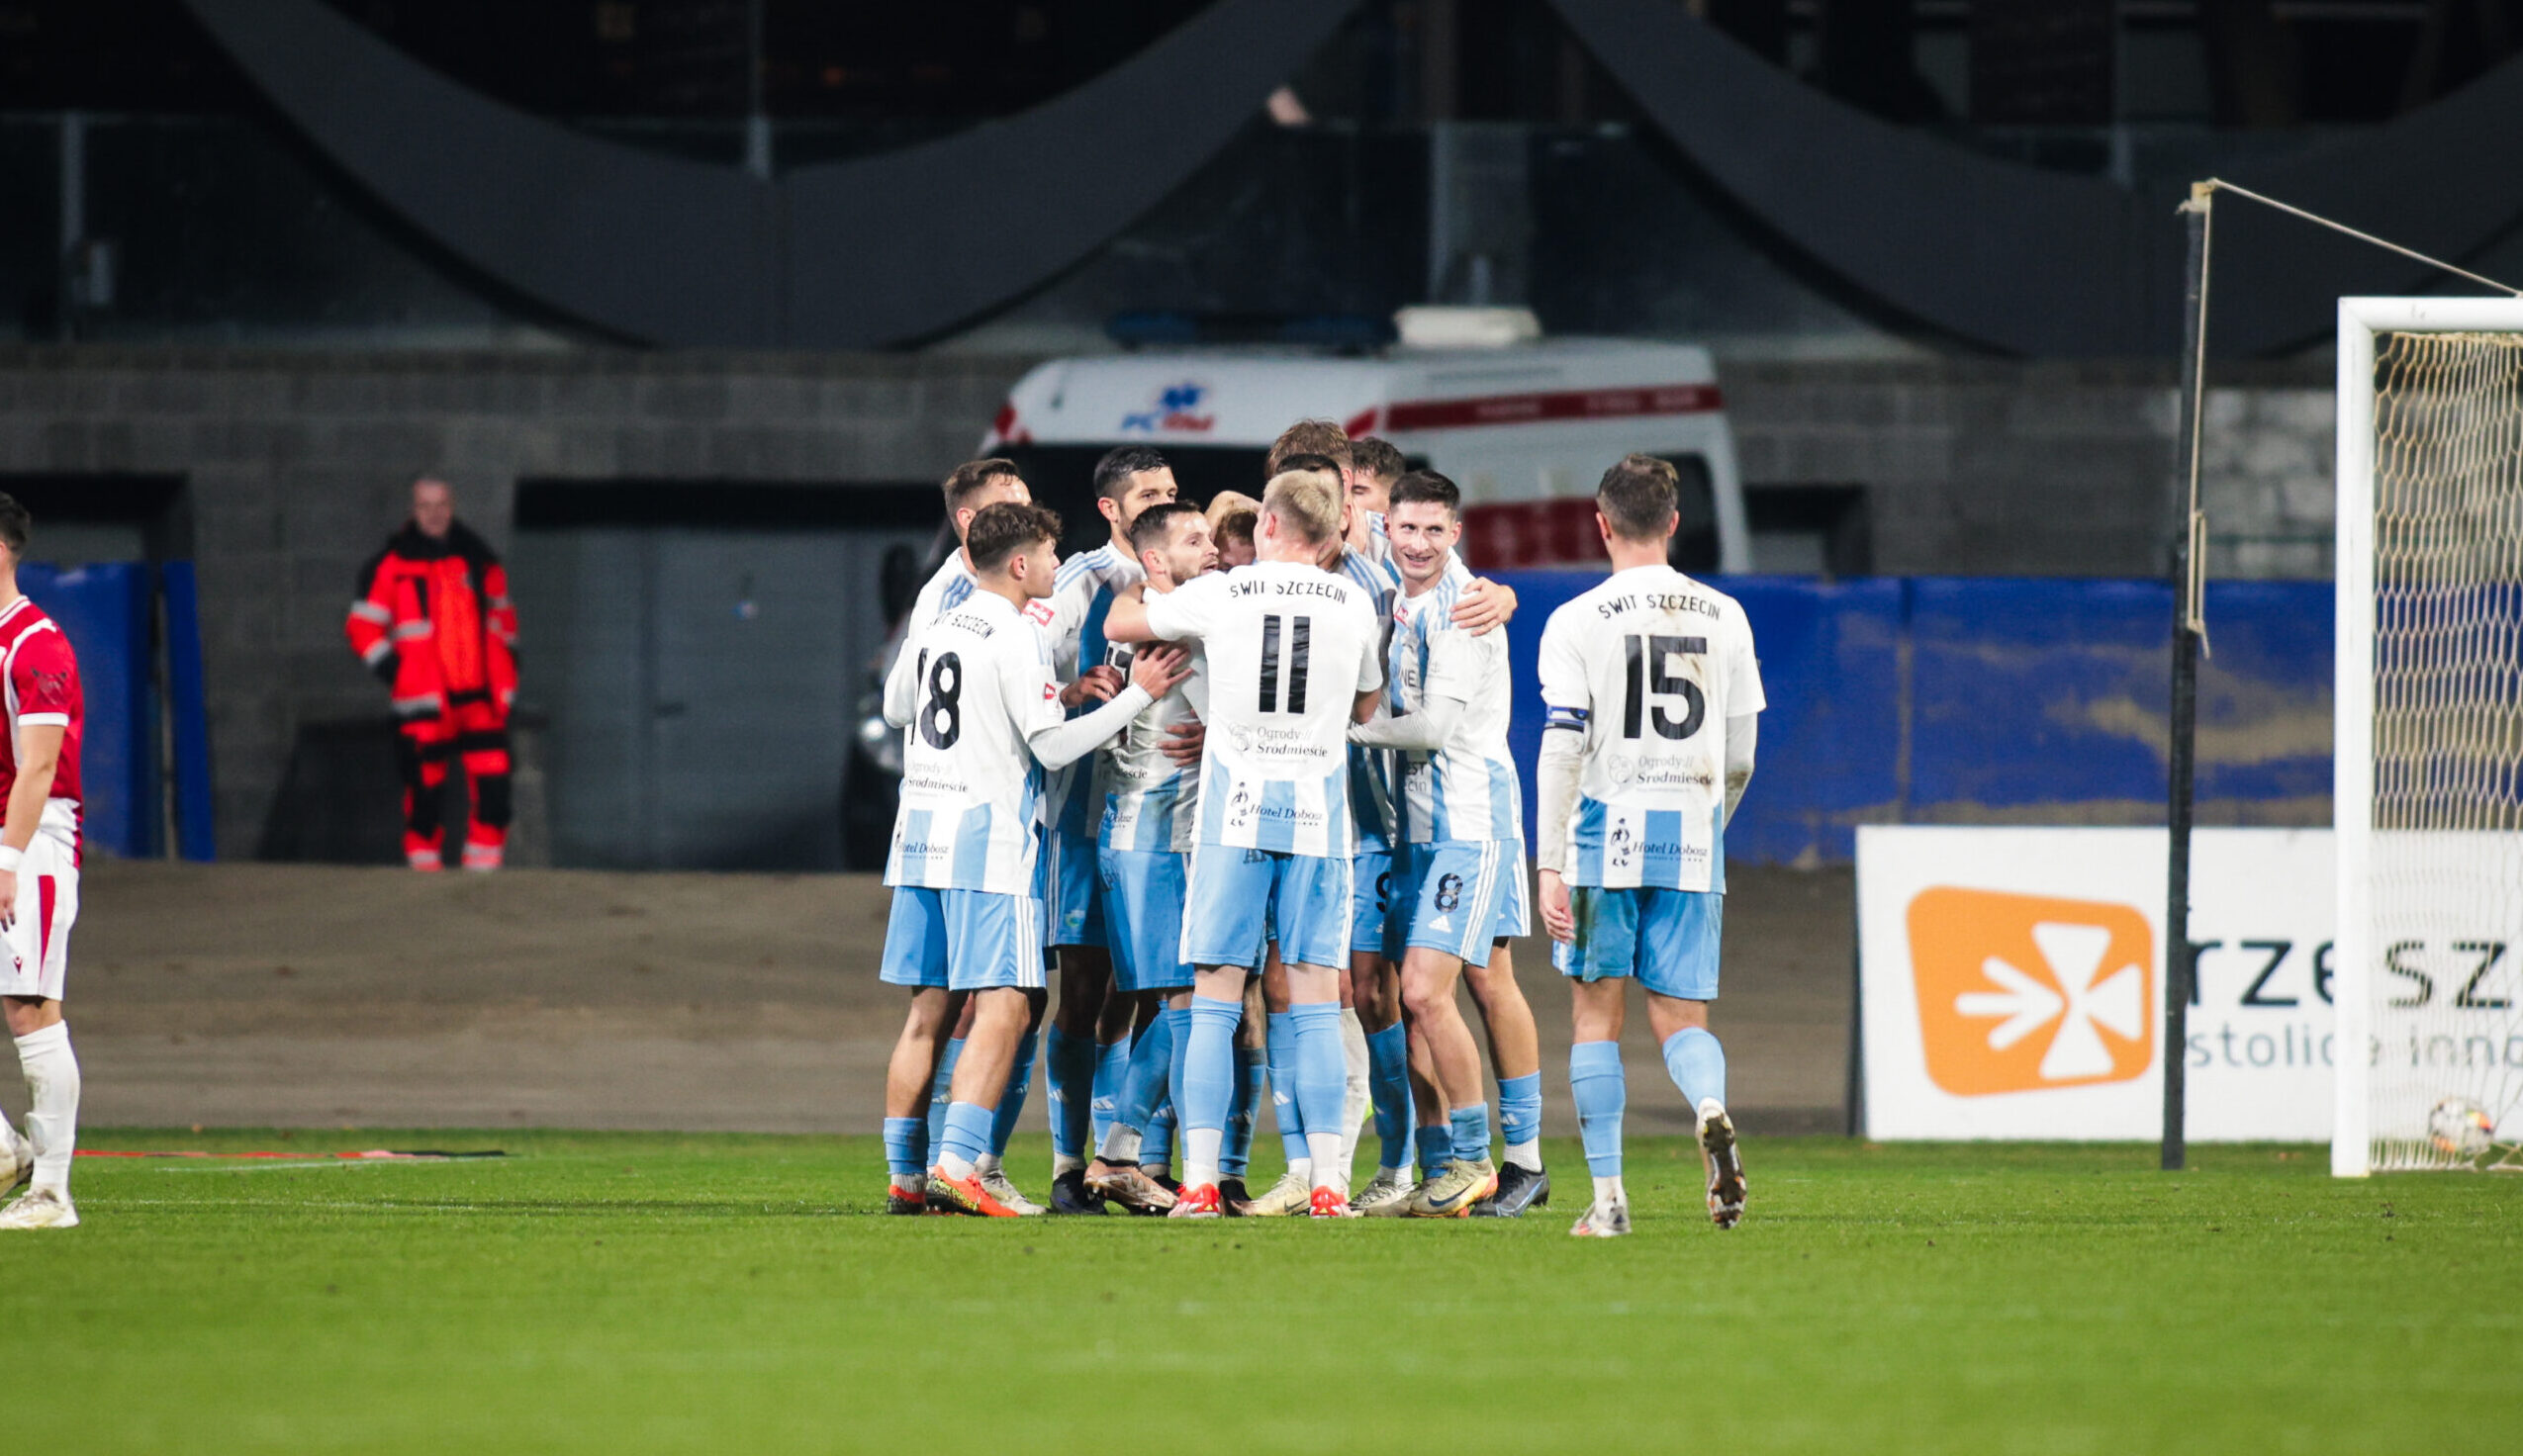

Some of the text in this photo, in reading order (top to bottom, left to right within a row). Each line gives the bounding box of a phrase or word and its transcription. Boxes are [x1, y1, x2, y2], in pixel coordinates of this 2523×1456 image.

[1276, 581, 1348, 604] SZCZECIN
[1647, 594, 1722, 620] SZCZECIN
[1259, 614, 1311, 714] 11
[910, 647, 962, 750] 18
[1624, 634, 1707, 740] 15
[1257, 726, 1301, 742] Ogrody
[1637, 755, 1683, 770] Ogrody
[1250, 804, 1323, 821] Hotel Dobosz
[1633, 841, 1708, 857] Hotel Dobosz
[1434, 873, 1463, 913] 8
